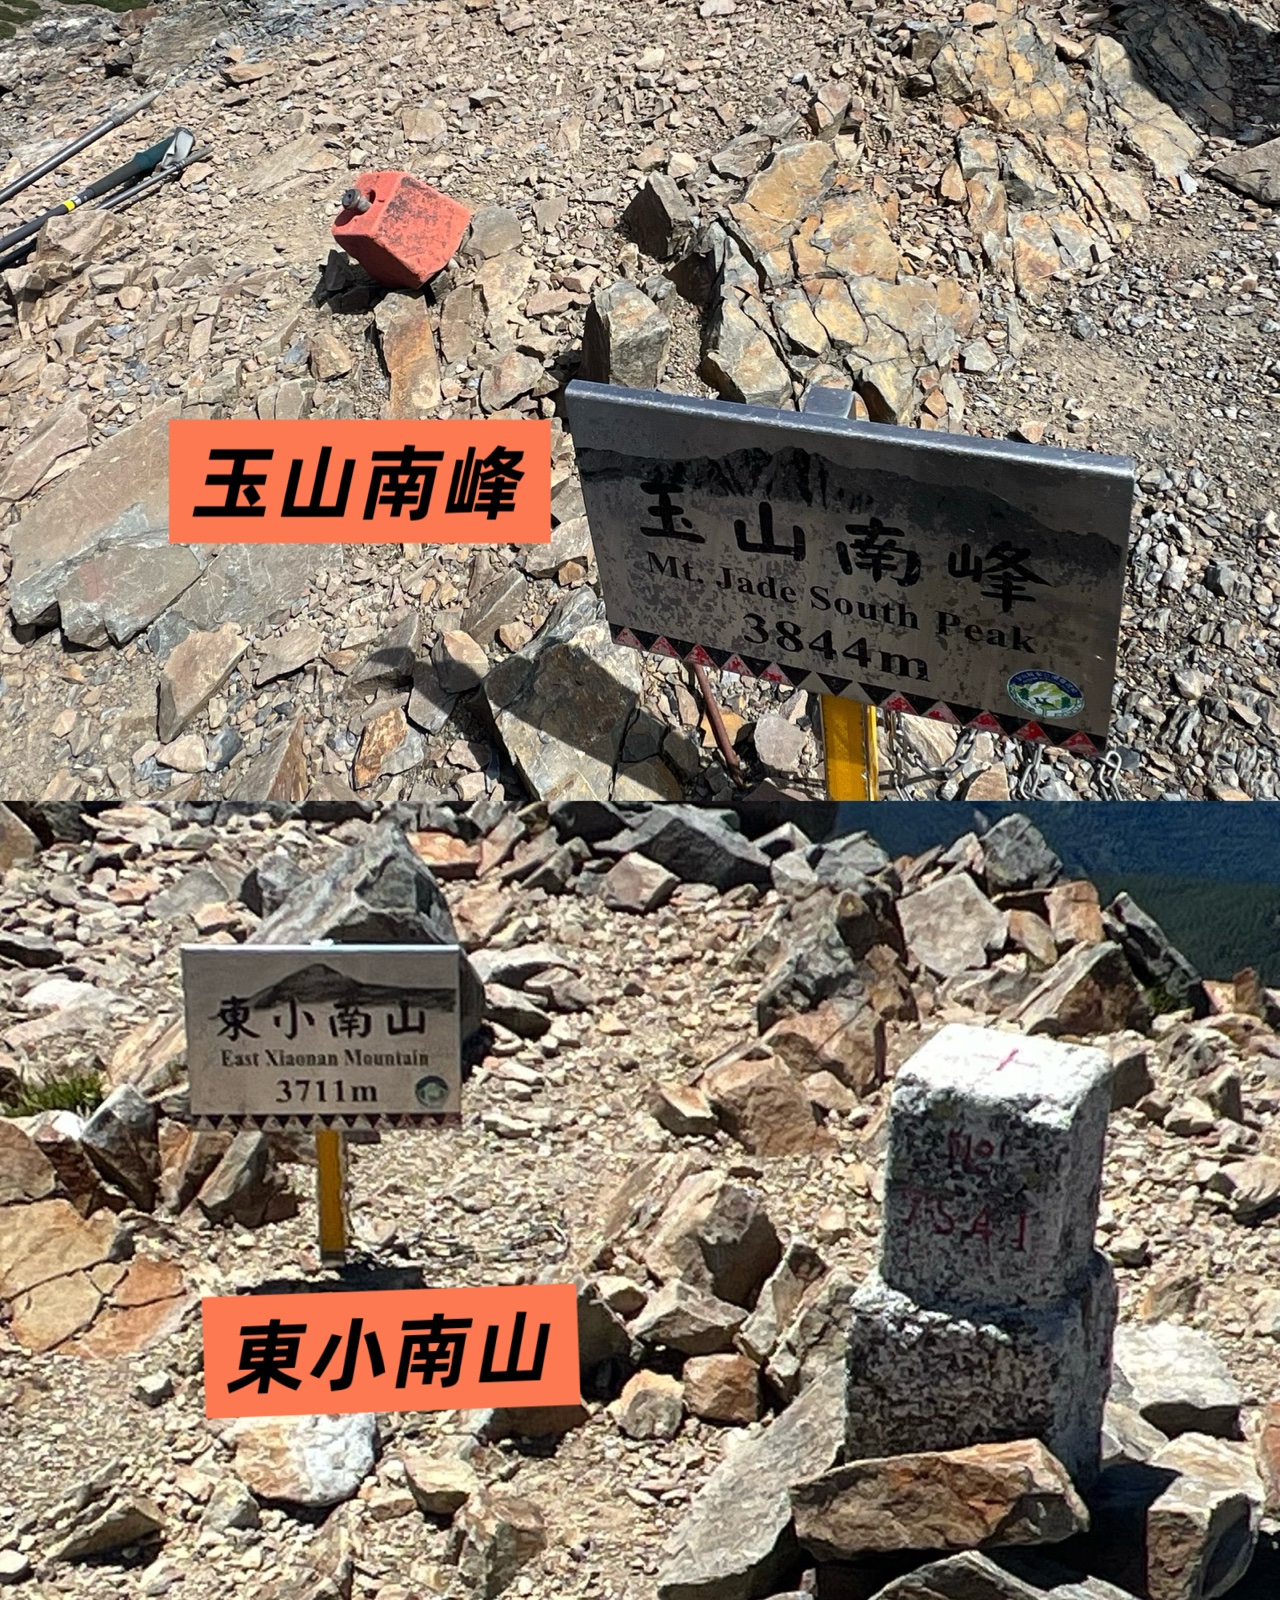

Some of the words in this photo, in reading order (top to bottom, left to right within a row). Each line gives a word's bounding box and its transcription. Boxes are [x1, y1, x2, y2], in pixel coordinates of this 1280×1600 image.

[639, 478, 1050, 613] 玉山南峰
[647, 551, 704, 584] Mt.
[716, 566, 796, 603] Jade
[809, 585, 920, 630] South
[935, 610, 1036, 653] Peak
[743, 612, 930, 682] 3844m
[208, 995, 426, 1042] 東小南山
[221, 1050, 259, 1067] East
[265, 1049, 338, 1067] Xiaonan
[344, 1050, 429, 1067] Mountain
[275, 1079, 378, 1104] 3711m
